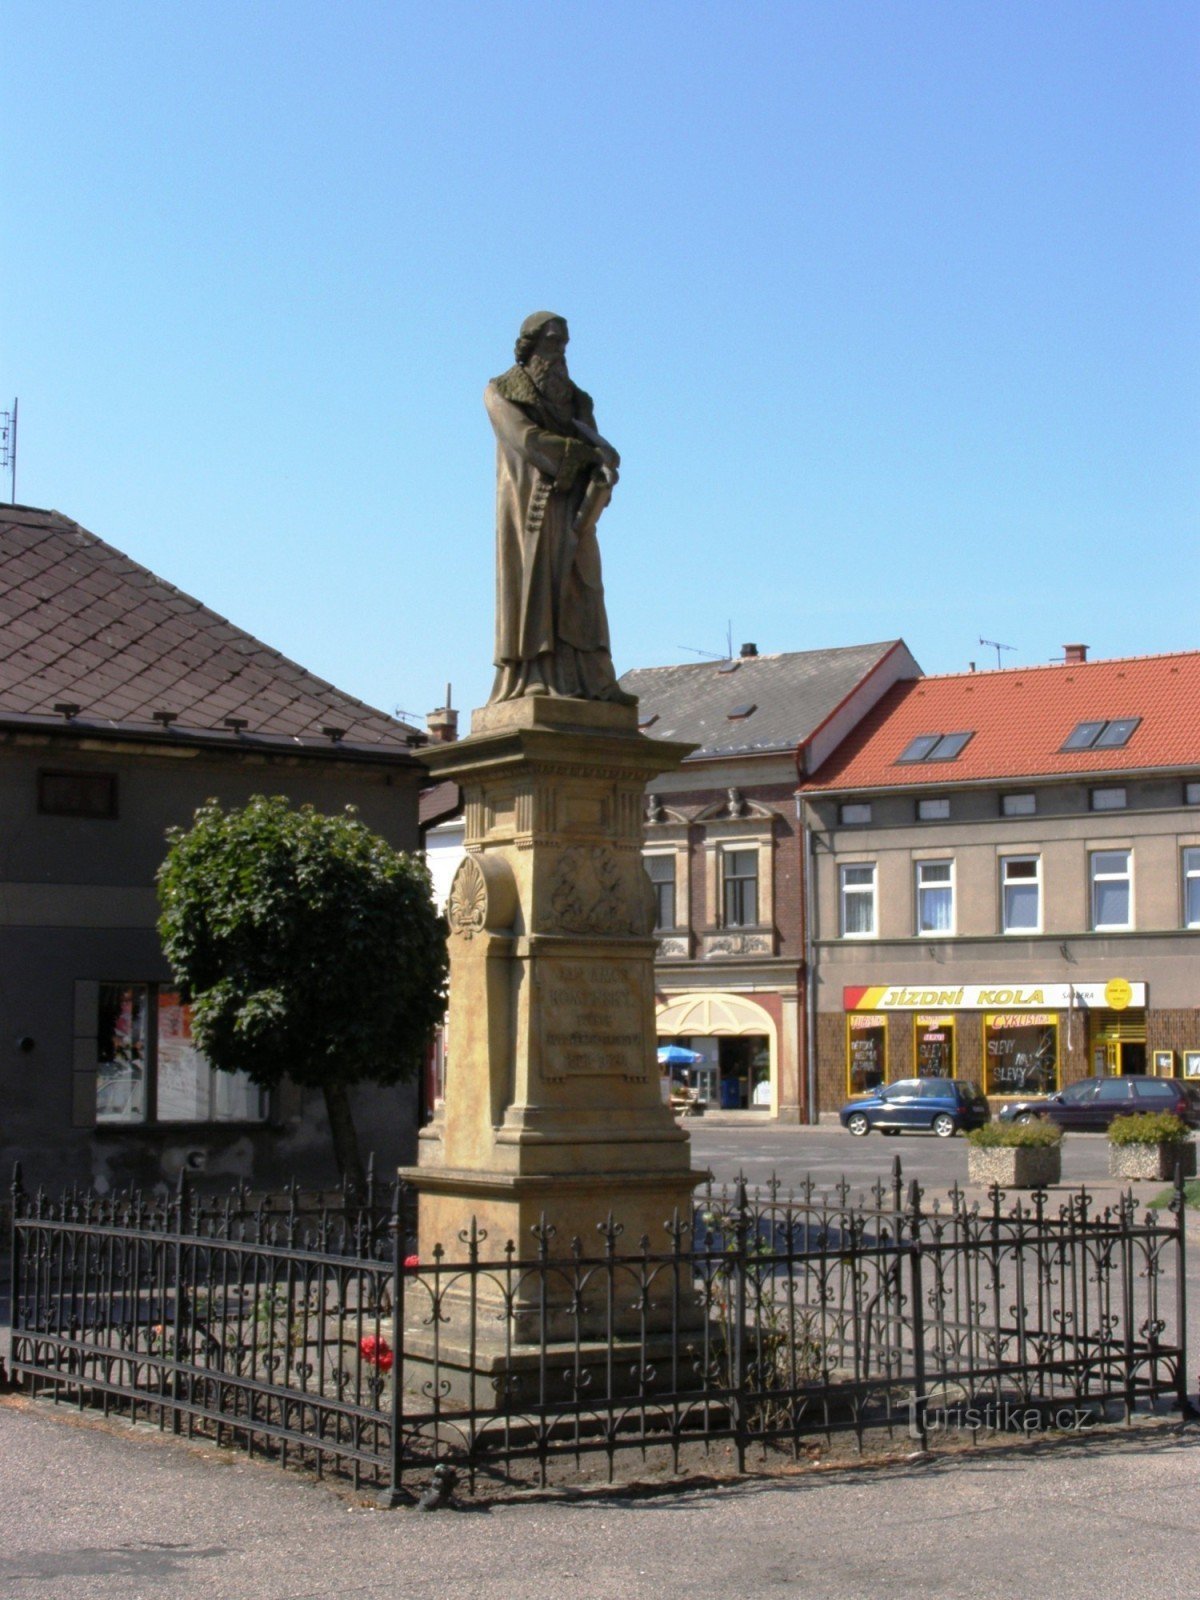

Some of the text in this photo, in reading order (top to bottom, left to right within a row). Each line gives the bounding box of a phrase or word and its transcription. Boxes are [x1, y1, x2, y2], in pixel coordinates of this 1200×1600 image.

[884, 987, 1044, 1006] JÍZDNÍ KOLA
[988, 1039, 1015, 1055] SLEVY
[993, 1066, 1026, 1083] SLEVY
